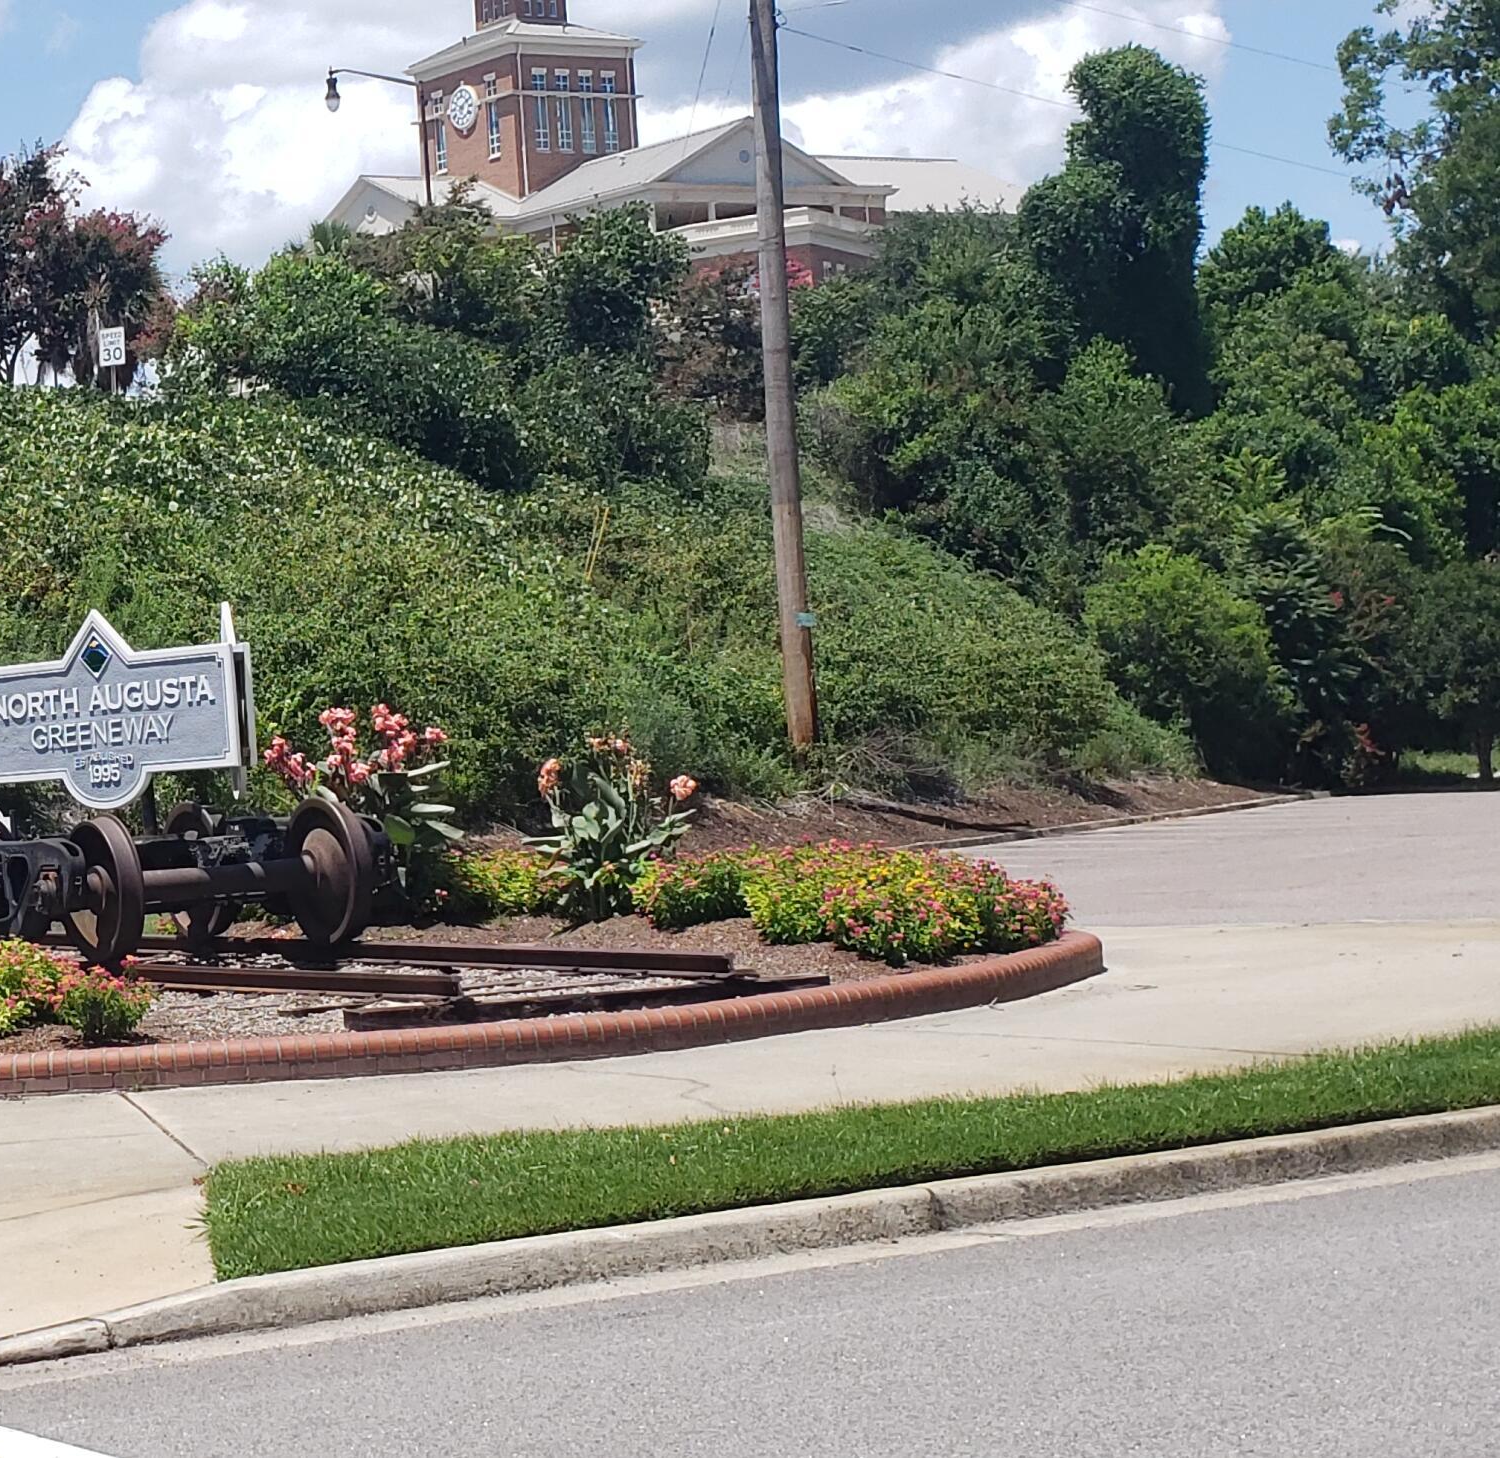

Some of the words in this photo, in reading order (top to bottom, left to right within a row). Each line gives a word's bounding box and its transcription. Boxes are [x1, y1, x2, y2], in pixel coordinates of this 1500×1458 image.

[103, 347, 122, 361] 30
[89, 674, 216, 713] AUGUSTA
[31, 713, 174, 750] GREENEWAY
[89, 763, 121, 783] 1995
